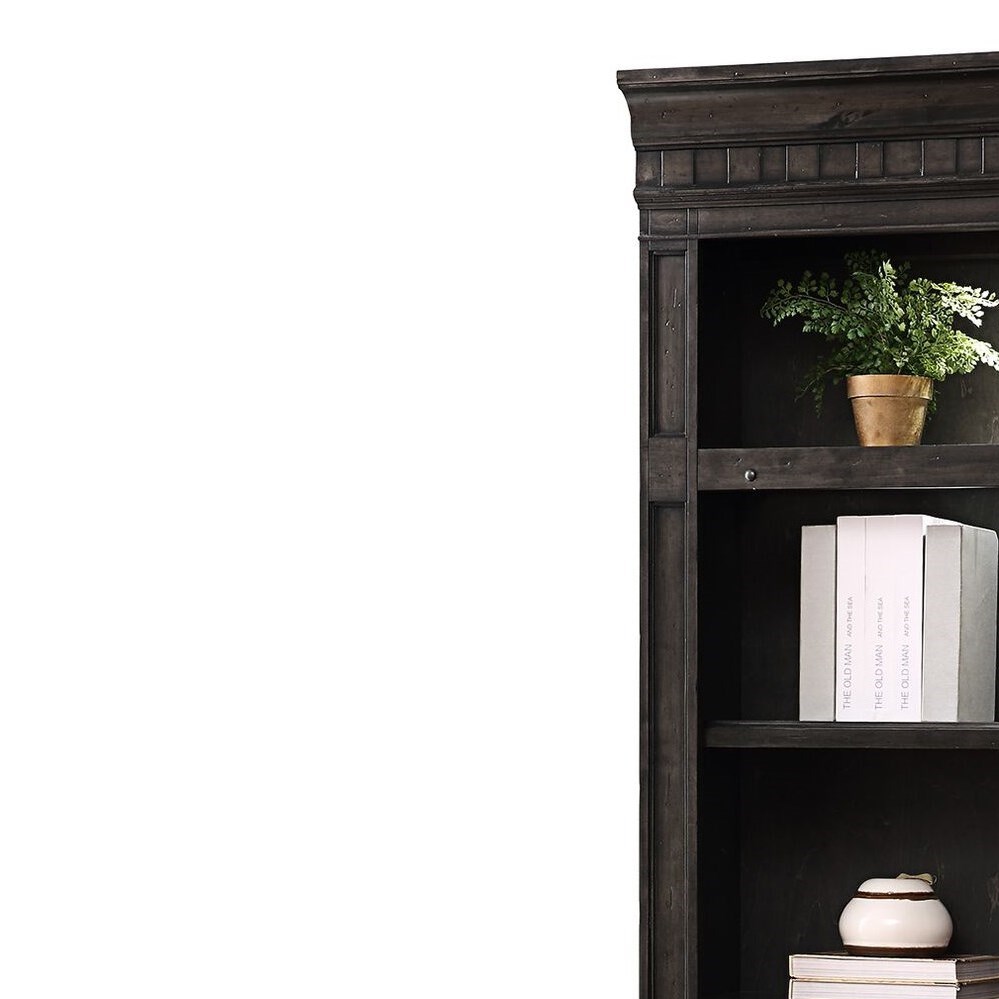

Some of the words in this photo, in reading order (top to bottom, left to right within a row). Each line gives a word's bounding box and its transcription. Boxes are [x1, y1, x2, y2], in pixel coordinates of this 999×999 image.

[844, 644, 853, 666] MAN
[875, 645, 884, 667] MAN
[901, 645, 910, 667] MAN
[843, 667, 852, 688] OLD
[875, 668, 883, 689] OLD
[901, 668, 910, 689] OLD
[843, 690, 852, 710] THE
[875, 691, 883, 710] THE
[901, 691, 909, 710] THE
